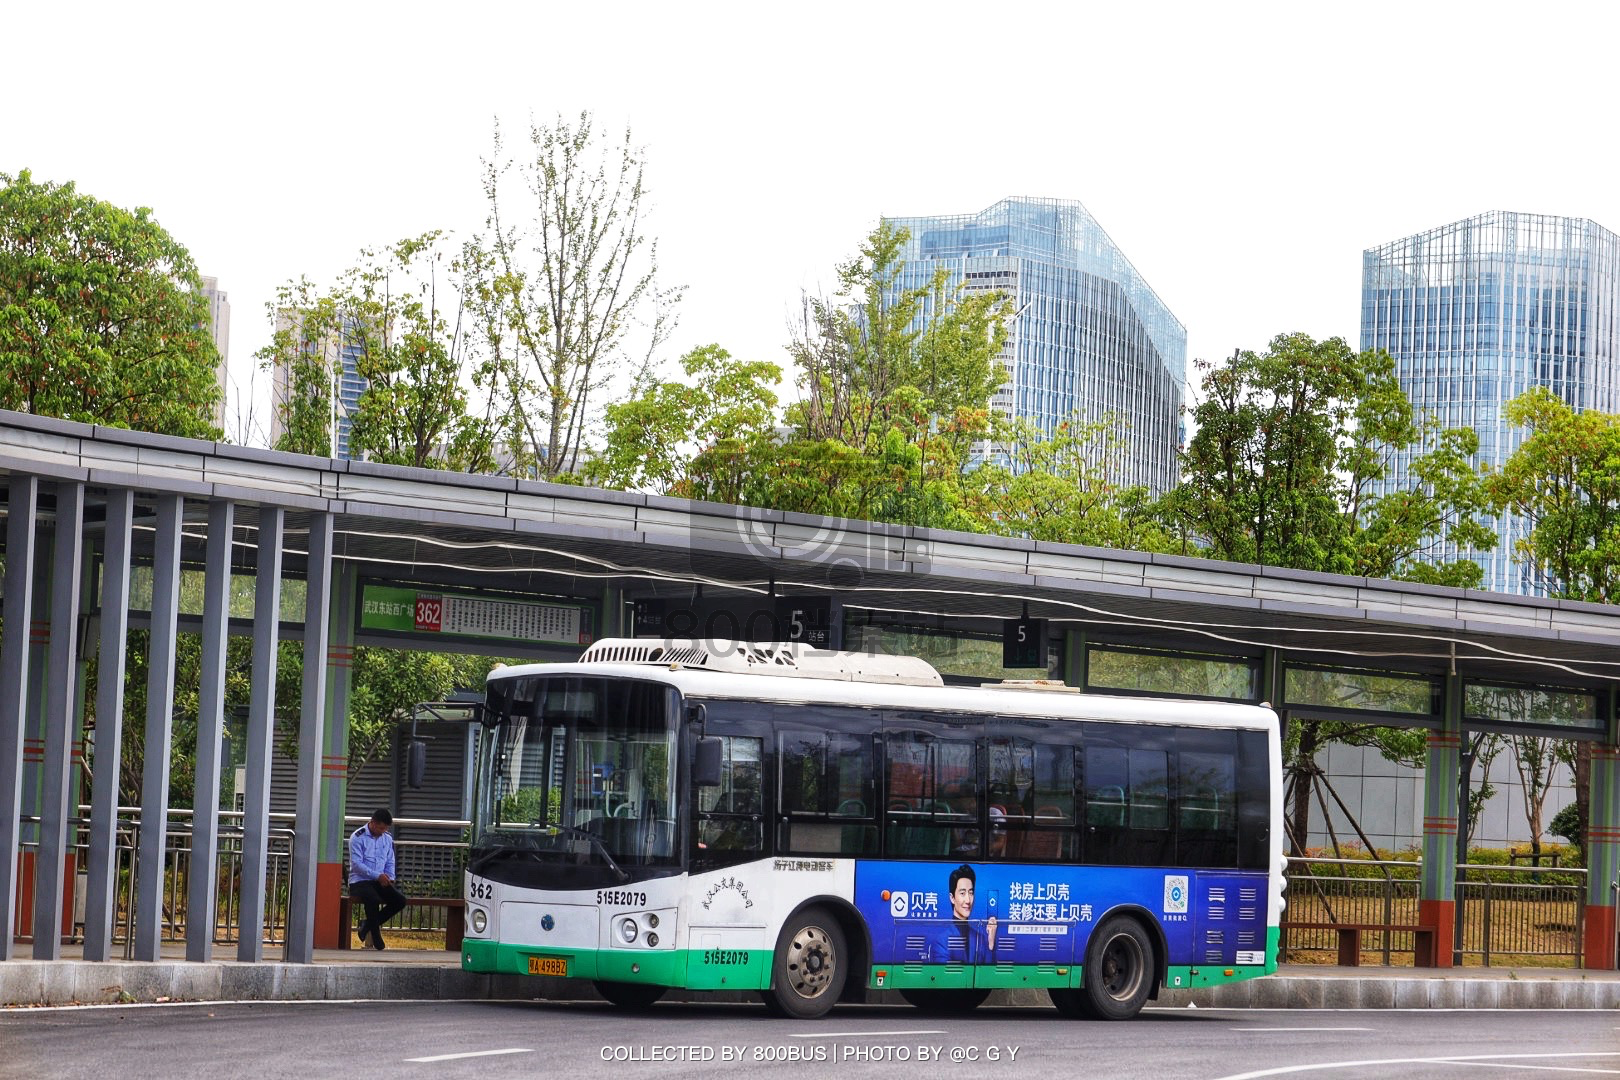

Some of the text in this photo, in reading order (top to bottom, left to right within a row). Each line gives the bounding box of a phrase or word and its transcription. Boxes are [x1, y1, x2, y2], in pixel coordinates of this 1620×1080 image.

[364, 600, 414, 618] 武汉东站西广场
[416, 602, 440, 624] 362
[790, 609, 804, 640] 5
[1017, 625, 1026, 642] 5
[808, 630, 825, 643] 站台
[470, 882, 493, 900] 362
[596, 890, 648, 907] 515E2079
[701, 876, 754, 911] 武汉公交集团公司
[1009, 882, 1070, 901] 找房上贝壳
[911, 891, 938, 911] 贝壳
[1008, 902, 1093, 922] 装修还要上贝壳
[704, 951, 749, 965] 515E2079
